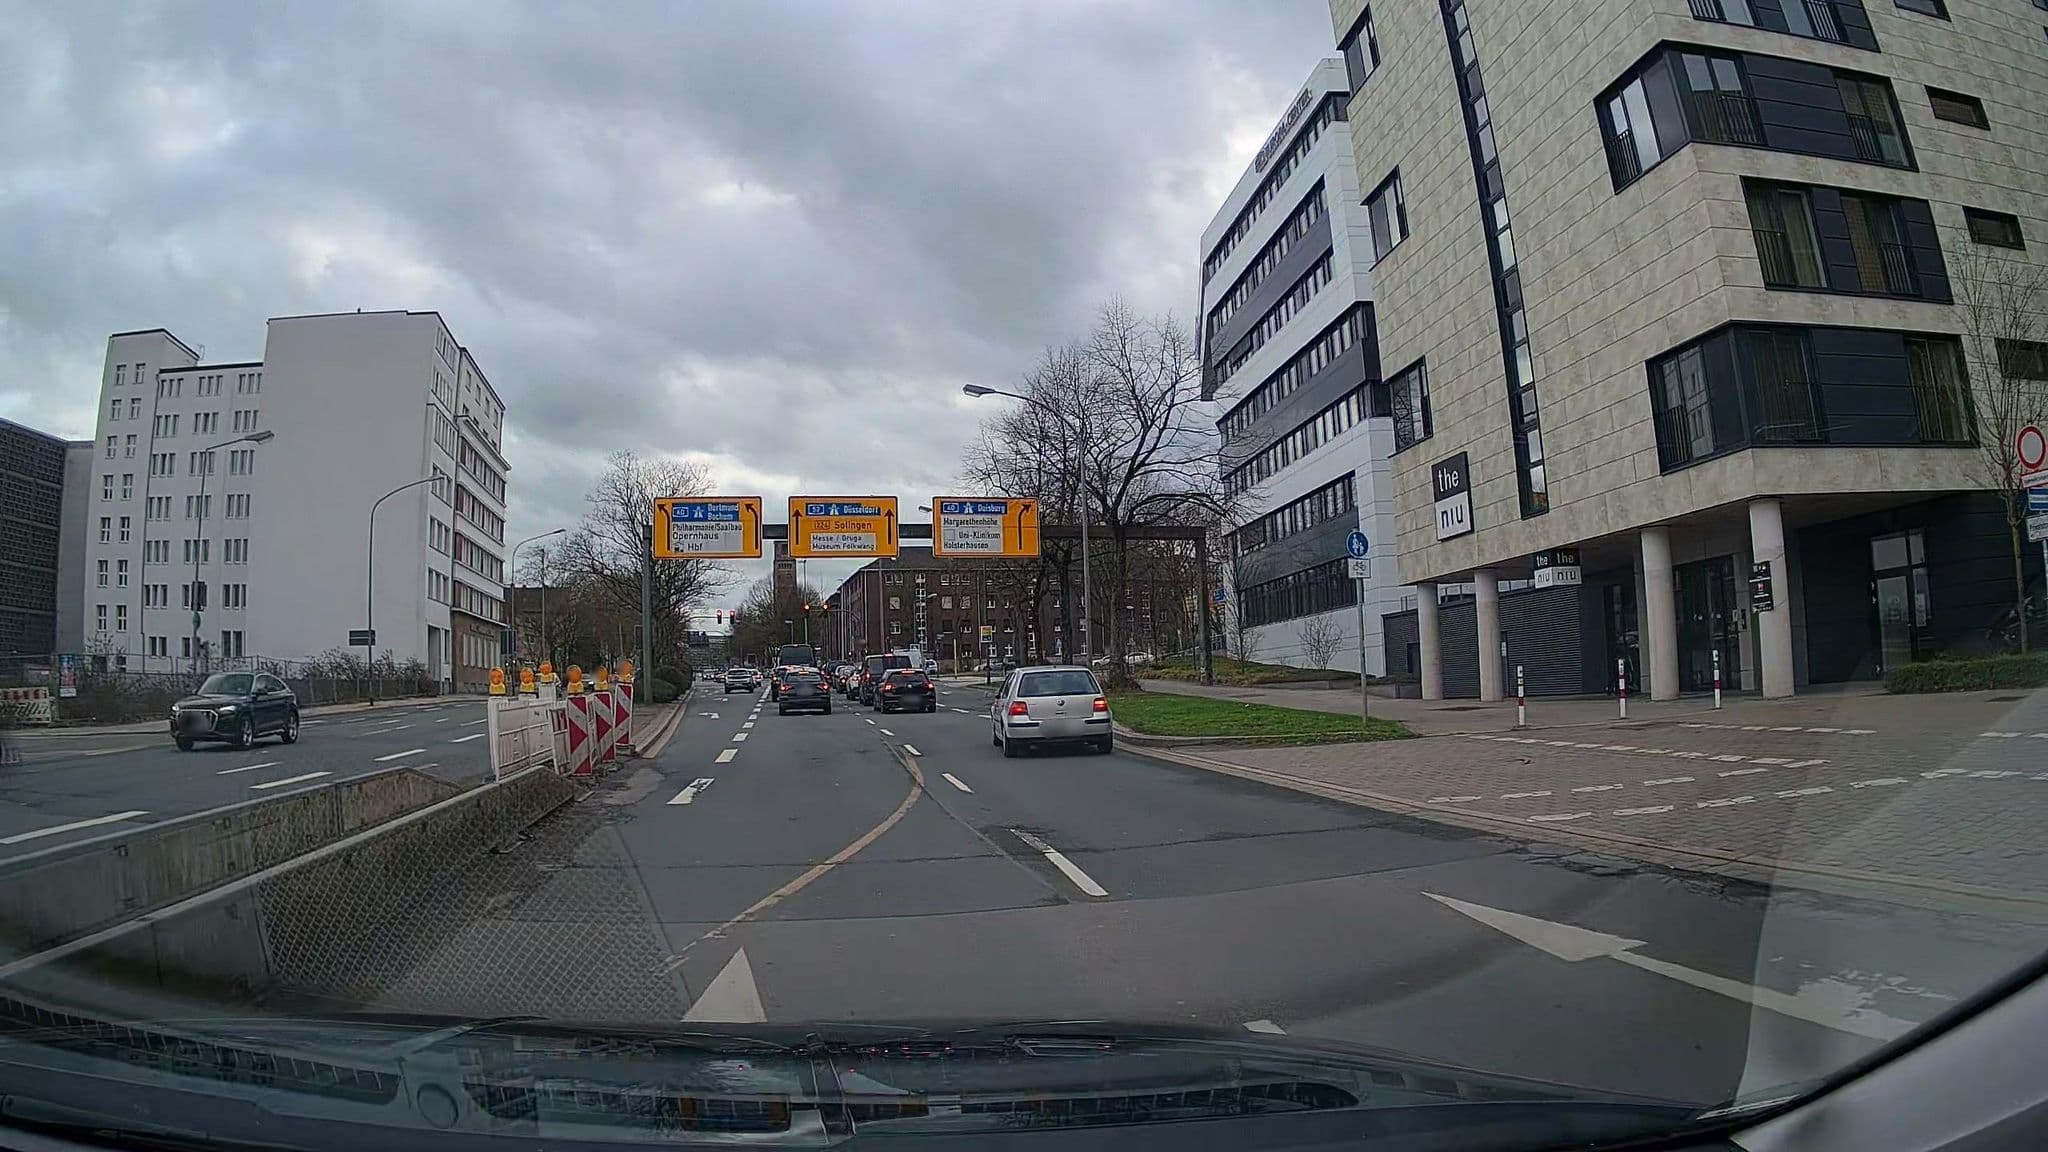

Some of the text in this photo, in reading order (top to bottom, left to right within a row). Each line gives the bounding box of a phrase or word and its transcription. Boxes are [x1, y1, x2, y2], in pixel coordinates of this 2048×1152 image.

[1438, 467, 1459, 492] the
[707, 504, 739, 512] Dortmund
[843, 504, 879, 514] Düsseldorf
[977, 503, 1006, 514] Duisburg
[707, 513, 733, 521] Bochum
[1441, 503, 1464, 529] niu
[834, 521, 872, 531] Solingen
[943, 517, 998, 527] Margarethenhöhe
[672, 532, 719, 540] Opernhaus
[841, 534, 862, 543] Gruga
[688, 543, 703, 551] Hbf
[812, 542, 875, 552] Museum Folkwang
[943, 542, 989, 550] Holsterhausen
